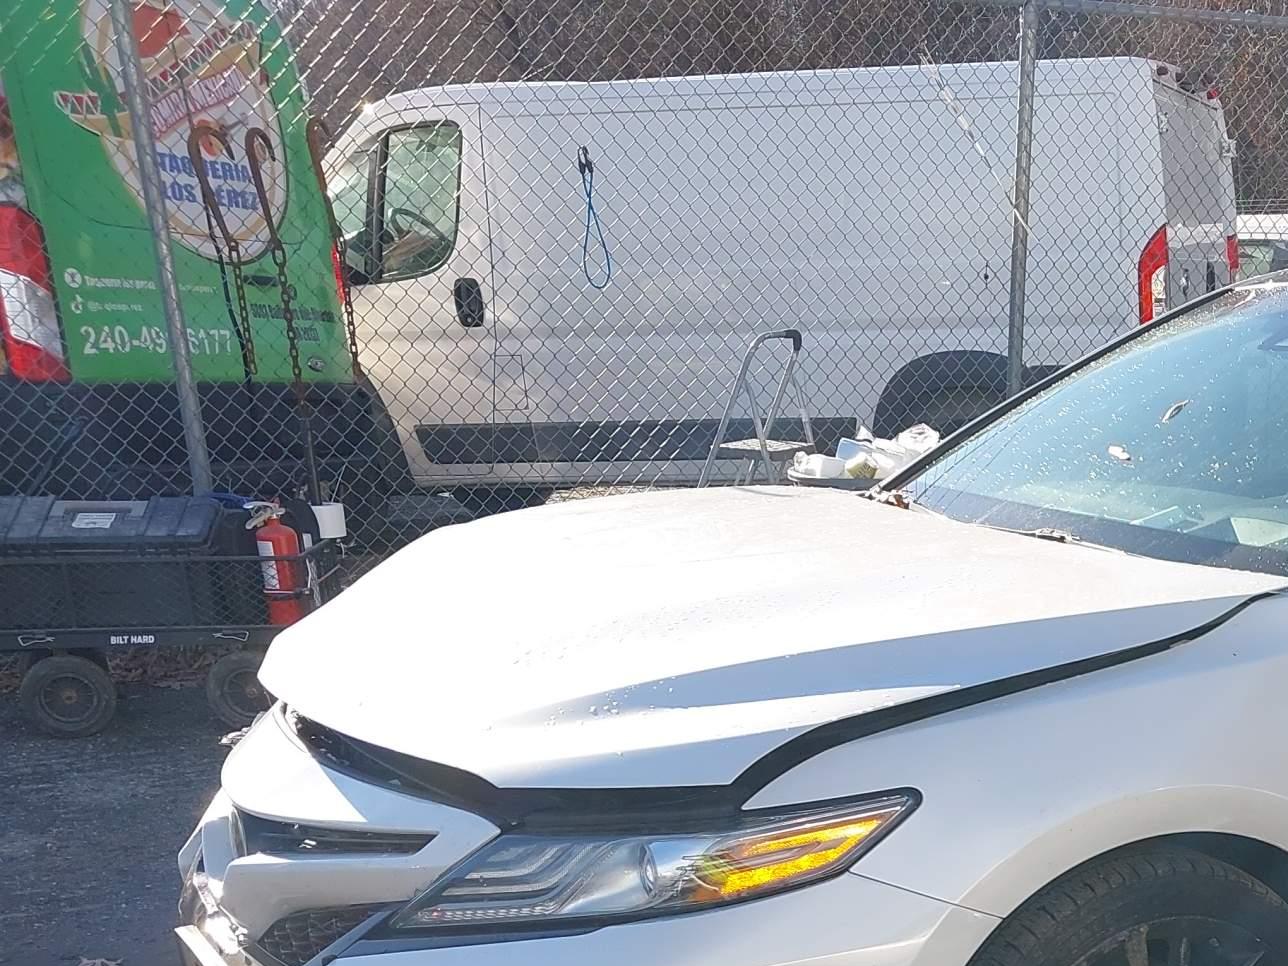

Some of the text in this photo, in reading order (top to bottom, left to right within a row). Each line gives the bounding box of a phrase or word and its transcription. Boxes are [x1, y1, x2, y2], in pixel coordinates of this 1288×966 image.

[212, 185, 259, 211] ÉREZ
[80, 325, 232, 355] 240-496177
[110, 635, 155, 644] BILT HARD
